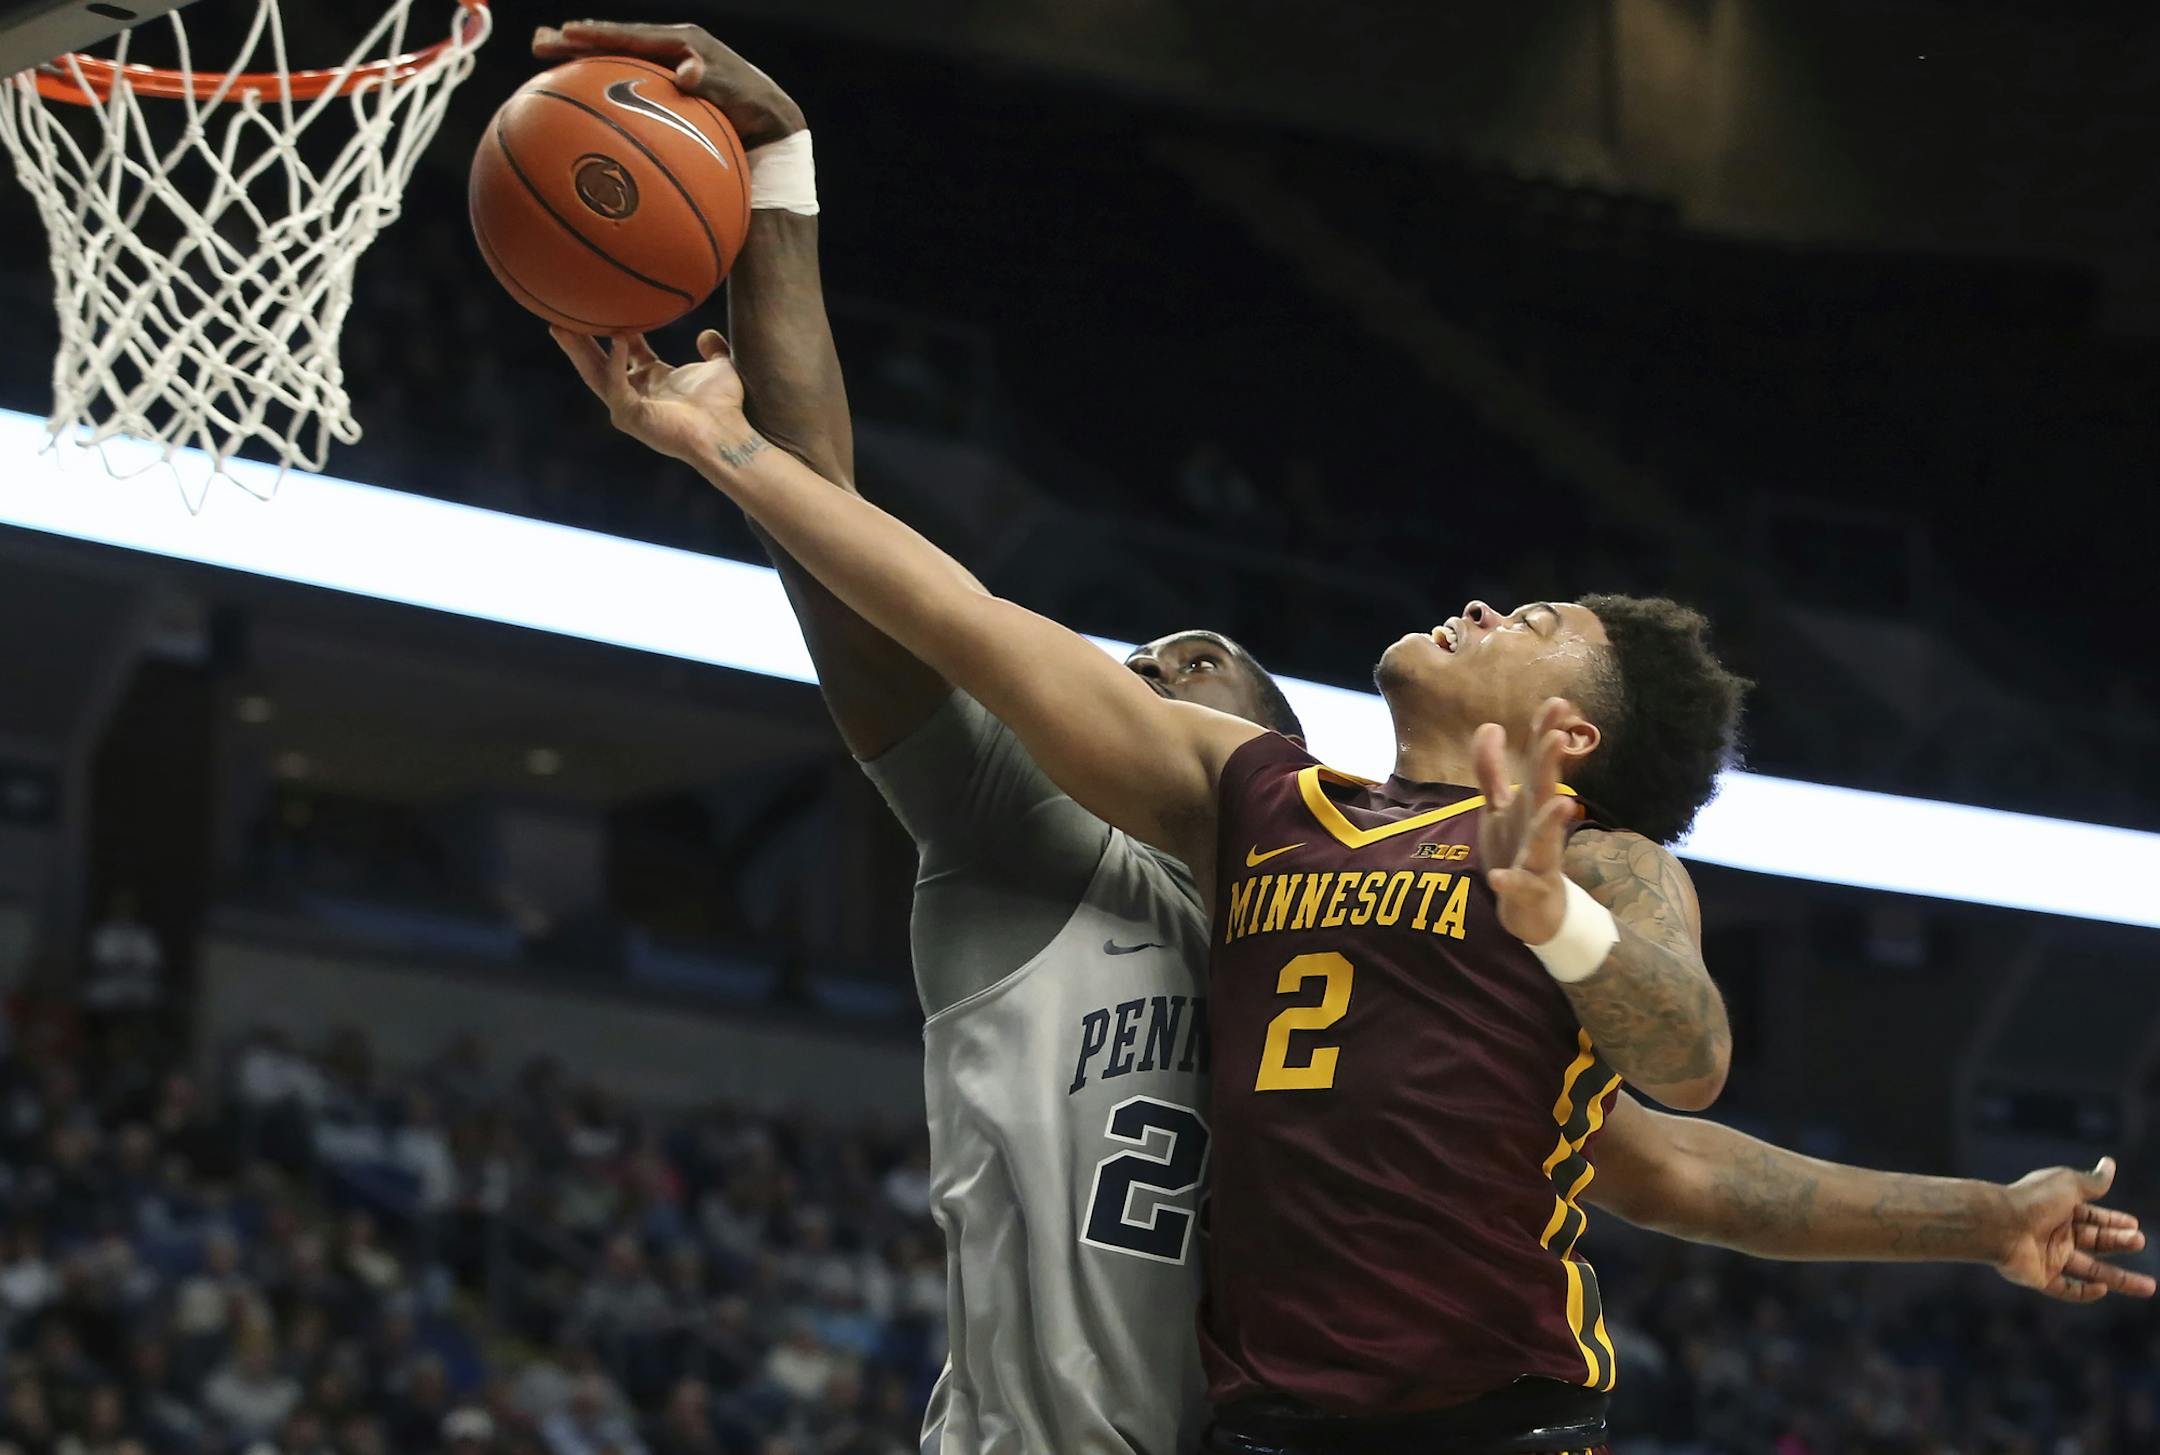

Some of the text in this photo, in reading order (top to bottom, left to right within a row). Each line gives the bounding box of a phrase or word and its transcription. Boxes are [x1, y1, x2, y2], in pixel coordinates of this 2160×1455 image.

[1225, 871, 1471, 944] MINNESOTA
[1254, 951, 1354, 1092] 2
[1079, 1094, 1212, 1266] 2
